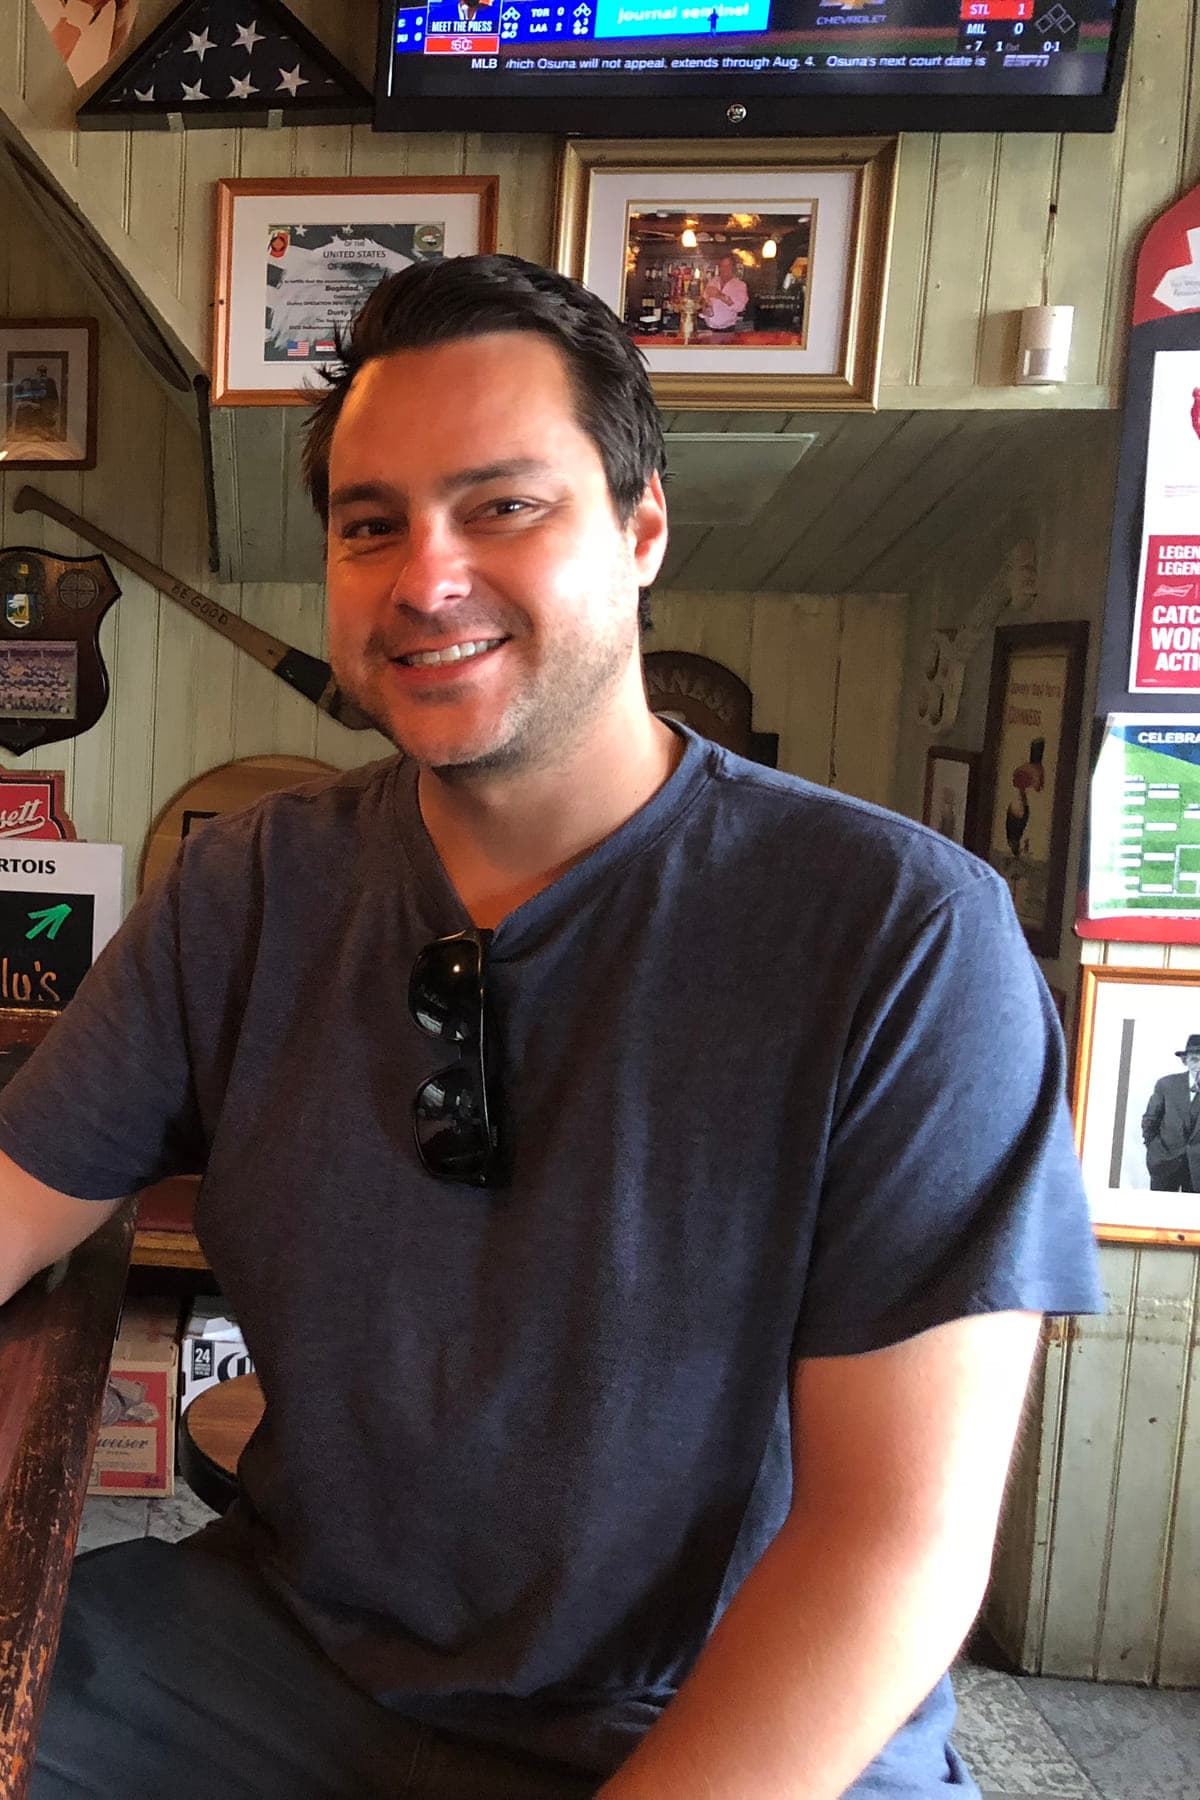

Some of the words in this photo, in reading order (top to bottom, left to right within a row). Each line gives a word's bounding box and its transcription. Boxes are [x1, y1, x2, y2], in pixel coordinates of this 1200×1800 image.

[531, 8, 550, 17] TOR
[557, 7, 565, 16] 0
[969, 4, 990, 15] STL
[1018, 4, 1025, 15] 1
[432, 21, 451, 32] MEET
[453, 21, 466, 32] THE
[468, 20, 492, 32] PRESS
[816, 14, 887, 26] CHEVROLET
[530, 23, 548, 33] LAA
[967, 23, 987, 35] MIL
[1014, 23, 1023, 35] 0
[975, 41, 982, 51] 7
[472, 58, 498, 69] MLB
[537, 58, 576, 69] Osuna
[579, 58, 598, 68] will
[602, 58, 621, 68] not
[671, 58, 719, 68] extends
[722, 57, 769, 70] through
[773, 57, 800, 70] Aug.
[826, 56, 876, 67] Osuna's
[880, 56, 908, 67] next
[910, 56, 943, 67] court
[945, 55, 972, 67] date
[975, 55, 986, 67] is
[1003, 54, 1050, 68] ESPN
[323, 251, 355, 259] UNITED
[357, 250, 386, 258] STATES
[327, 309, 349, 317] Durty
[171, 583, 189, 599] BE
[191, 596, 229, 627] GOOD
[1152, 605, 1200, 625] CATC
[1138, 732, 1200, 744] CELEBRA
[195, 1348, 211, 1363] 24
